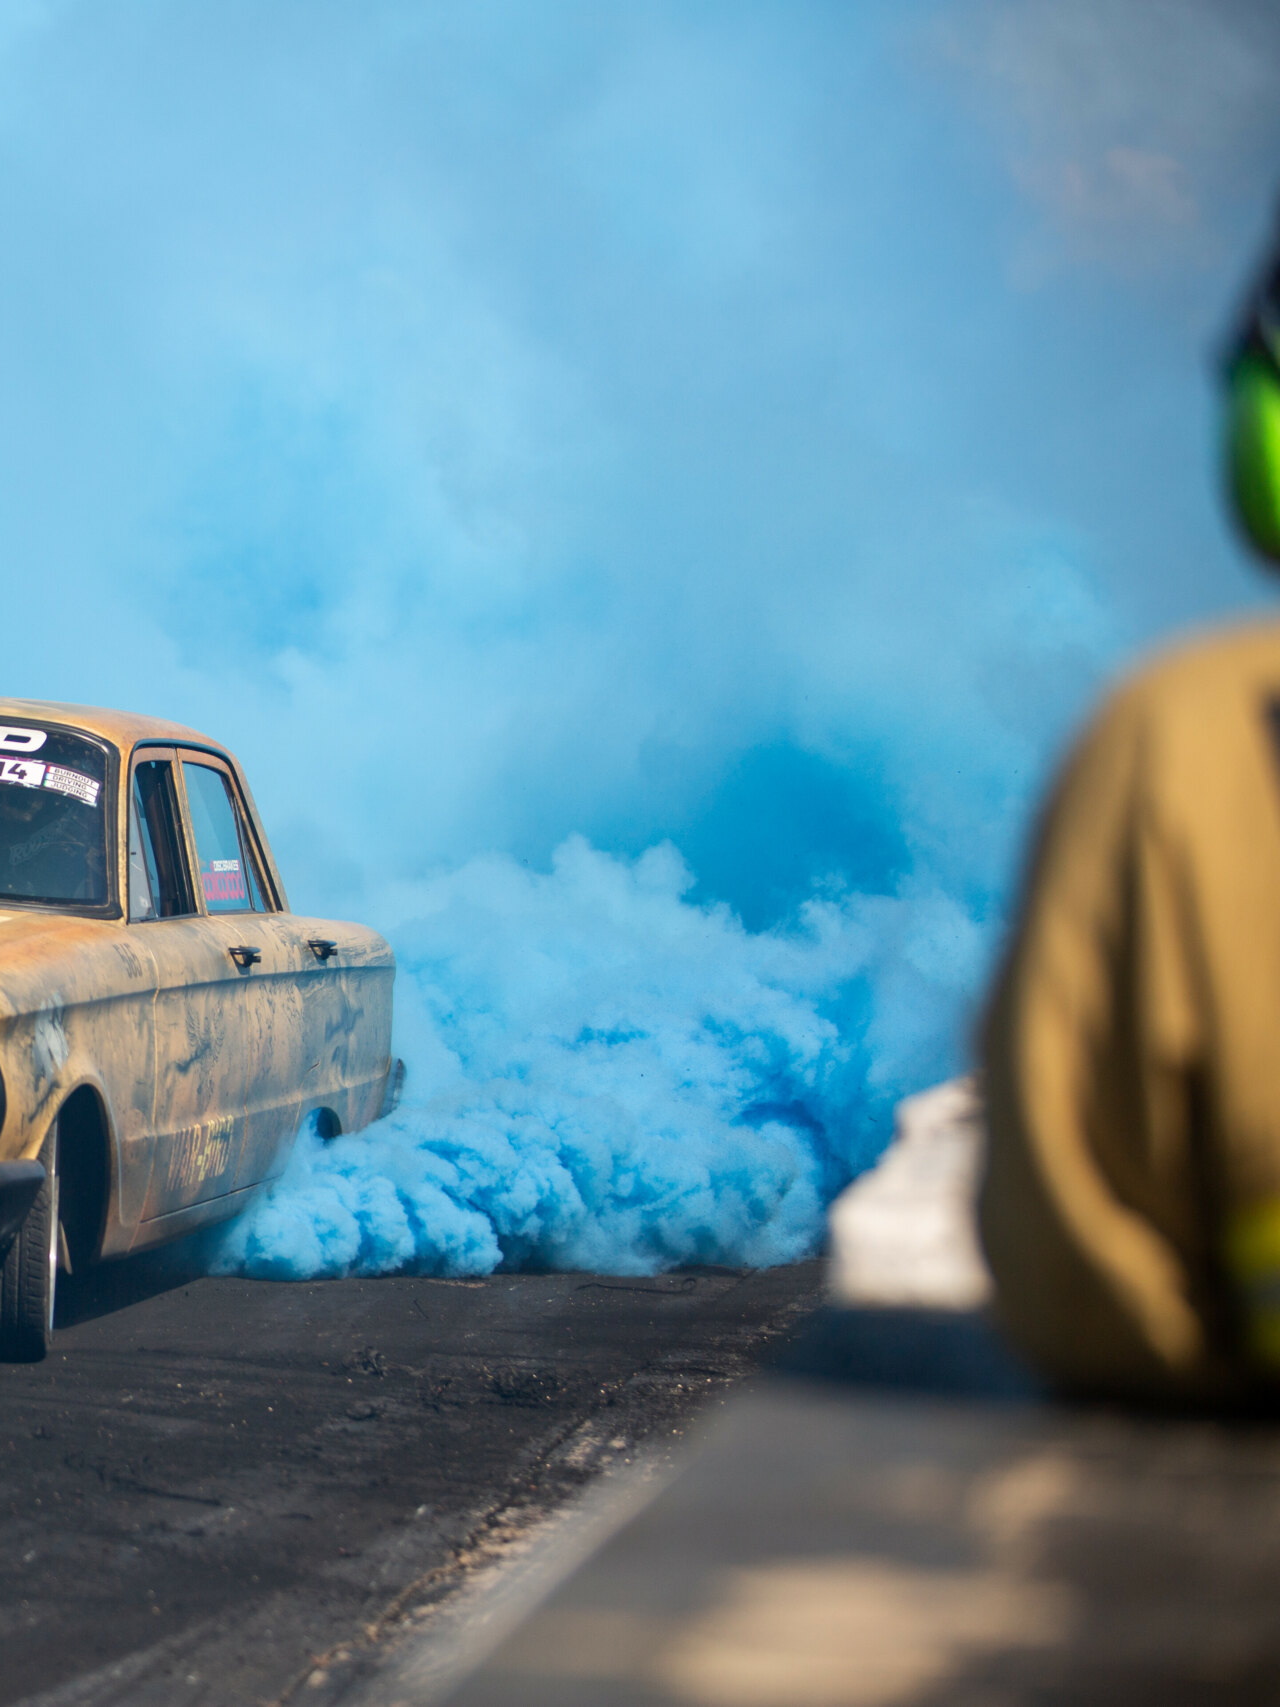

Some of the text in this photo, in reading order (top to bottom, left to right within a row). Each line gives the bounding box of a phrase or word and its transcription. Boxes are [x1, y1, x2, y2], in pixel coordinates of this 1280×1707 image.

[52, 775, 87, 790] DRIVING
[54, 768, 94, 786] BURNOUT
[51, 782, 87, 798] JUDGING
